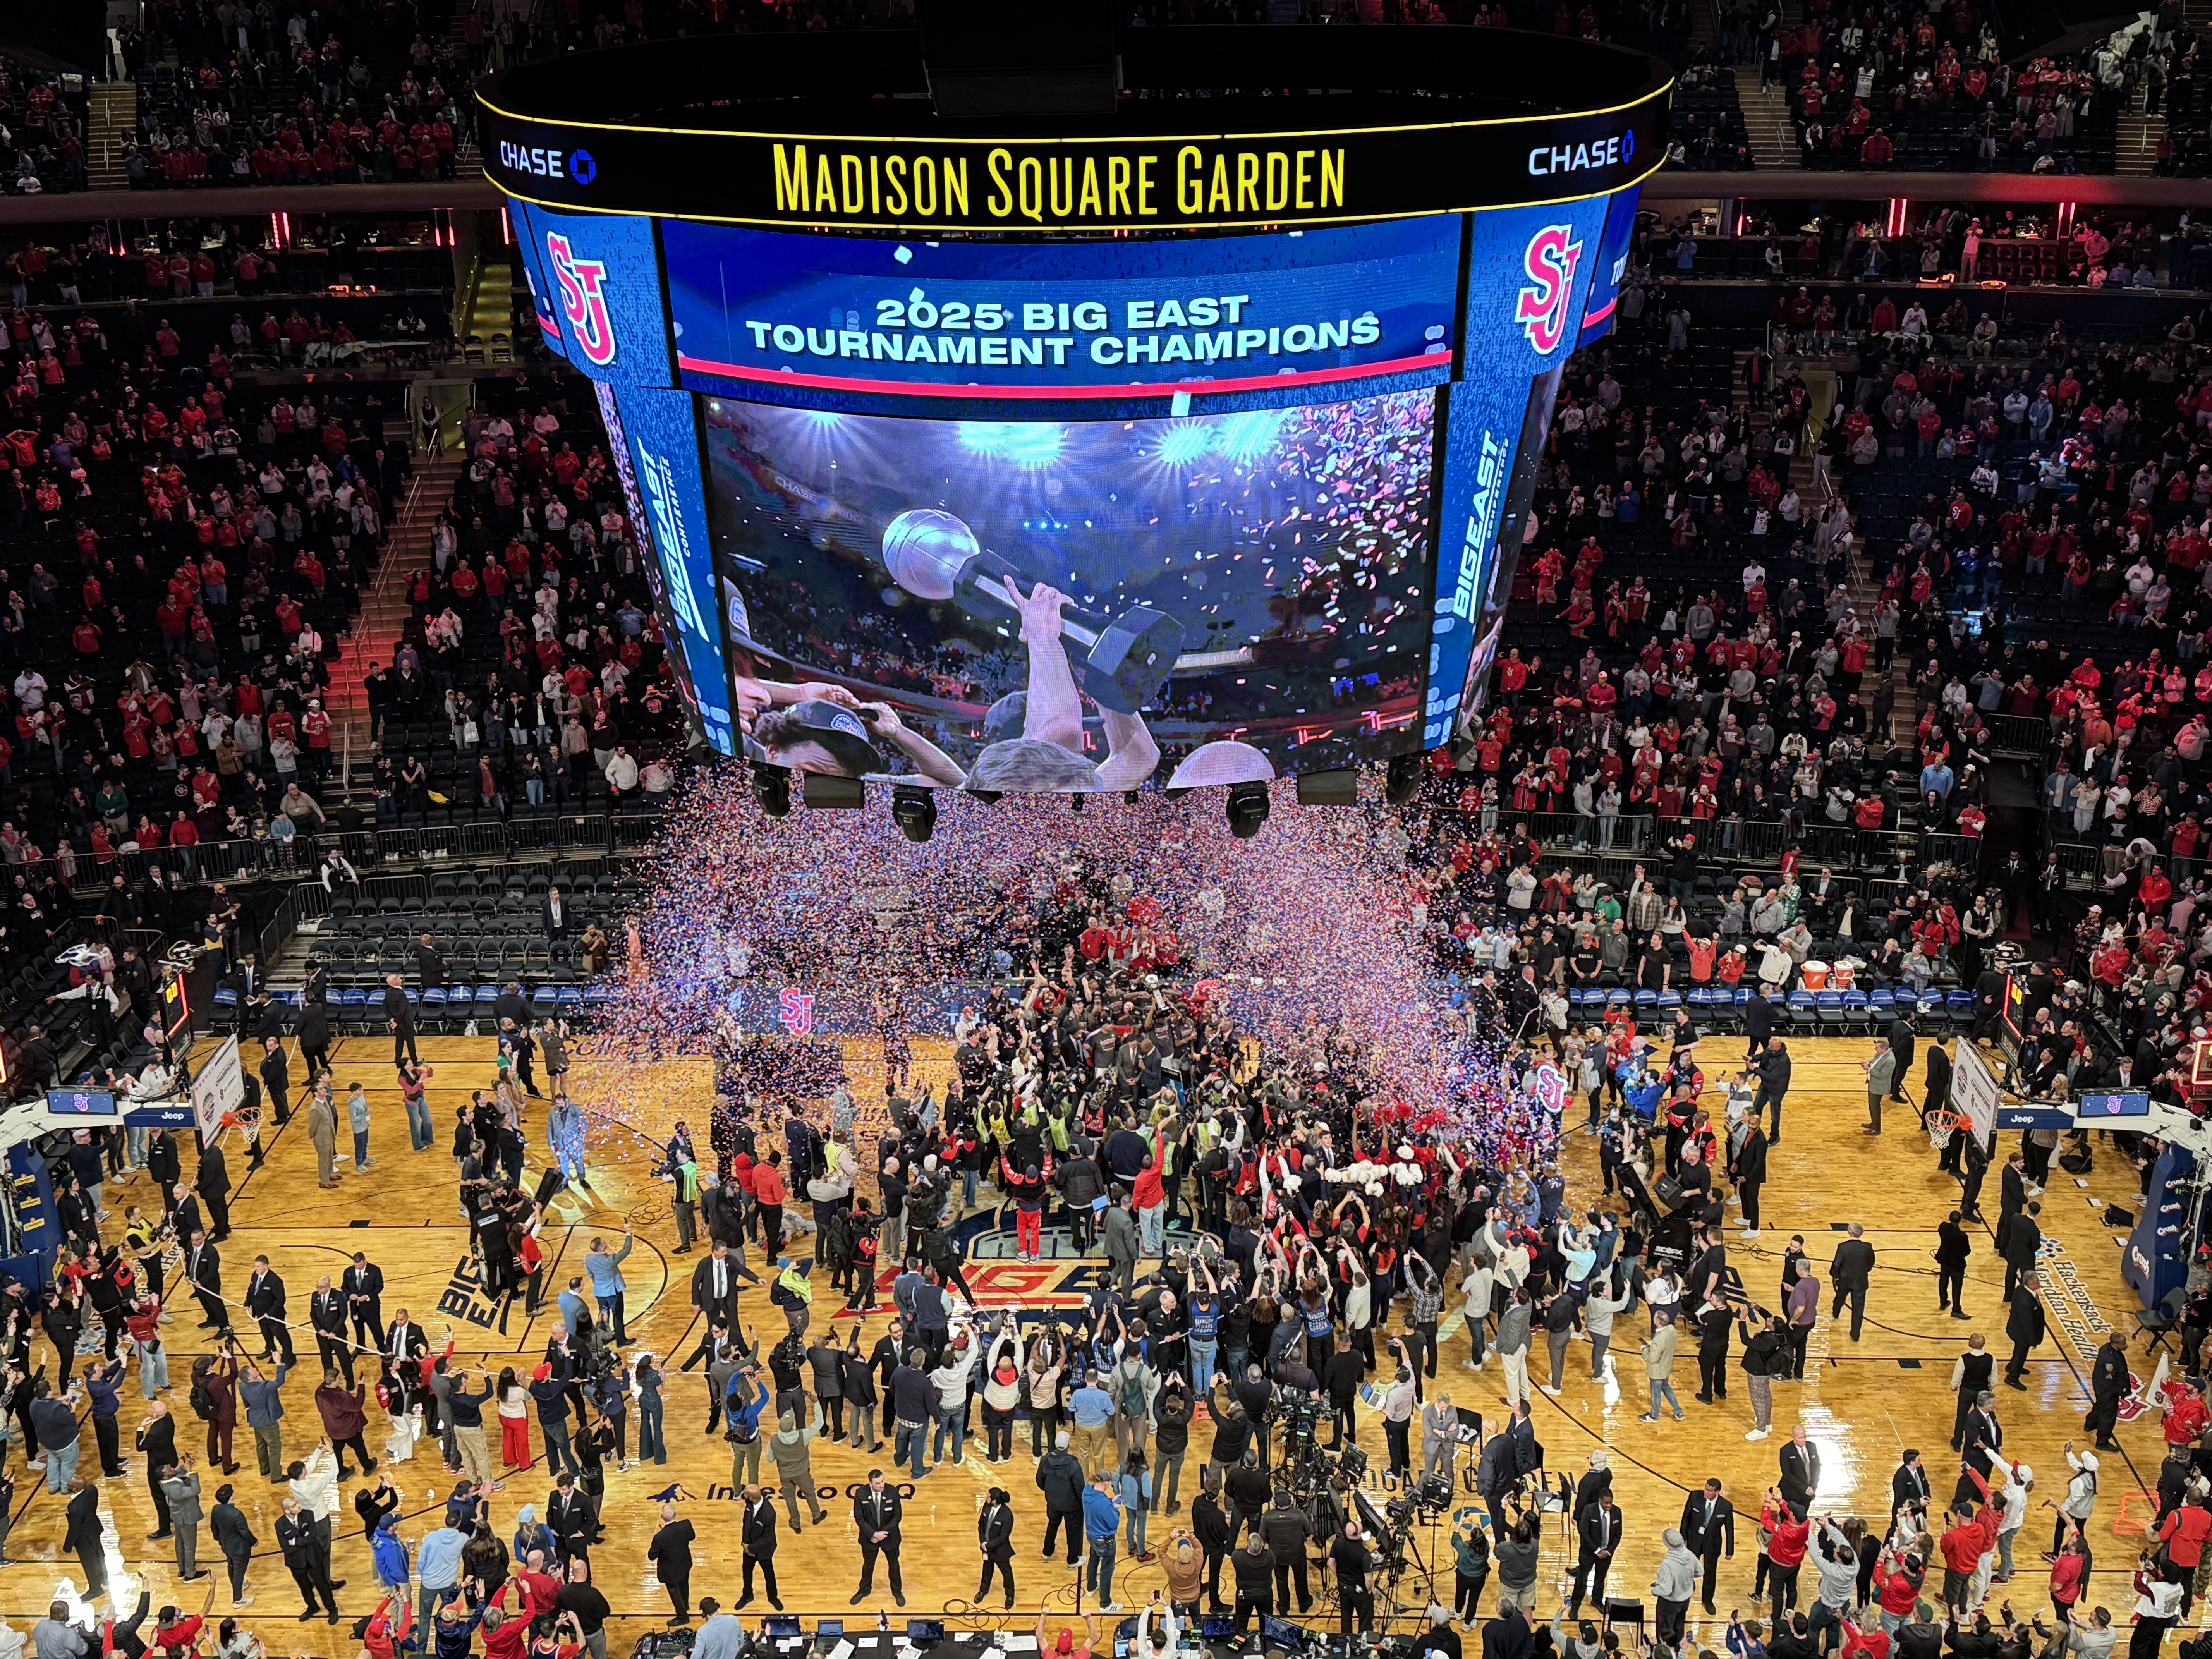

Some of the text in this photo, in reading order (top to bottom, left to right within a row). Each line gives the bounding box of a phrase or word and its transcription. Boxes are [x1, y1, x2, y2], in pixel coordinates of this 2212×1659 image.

[501, 141, 564, 177] CHASE
[1529, 137, 1620, 175] CHASE
[773, 144, 1345, 222] MADISON SQUARE GARDEN
[877, 295, 1249, 331] 2025 BIG EAST
[746, 316, 1380, 365] TOURNAMENT CHAMPIONS
[661, 455, 691, 558] CONFERENCE
[161, 1111, 184, 1120] Jeep
[2011, 1115, 2034, 1124] Jeep
[2165, 1178, 2185, 1188] Crush
[2160, 1202, 2181, 1213] Crush
[2157, 1224, 2178, 1237] Crush
[2132, 1245, 2150, 1278] Crush
[2035, 1261, 2099, 1360] Meridian Health
[2052, 1260, 2114, 1333] Hackensack
